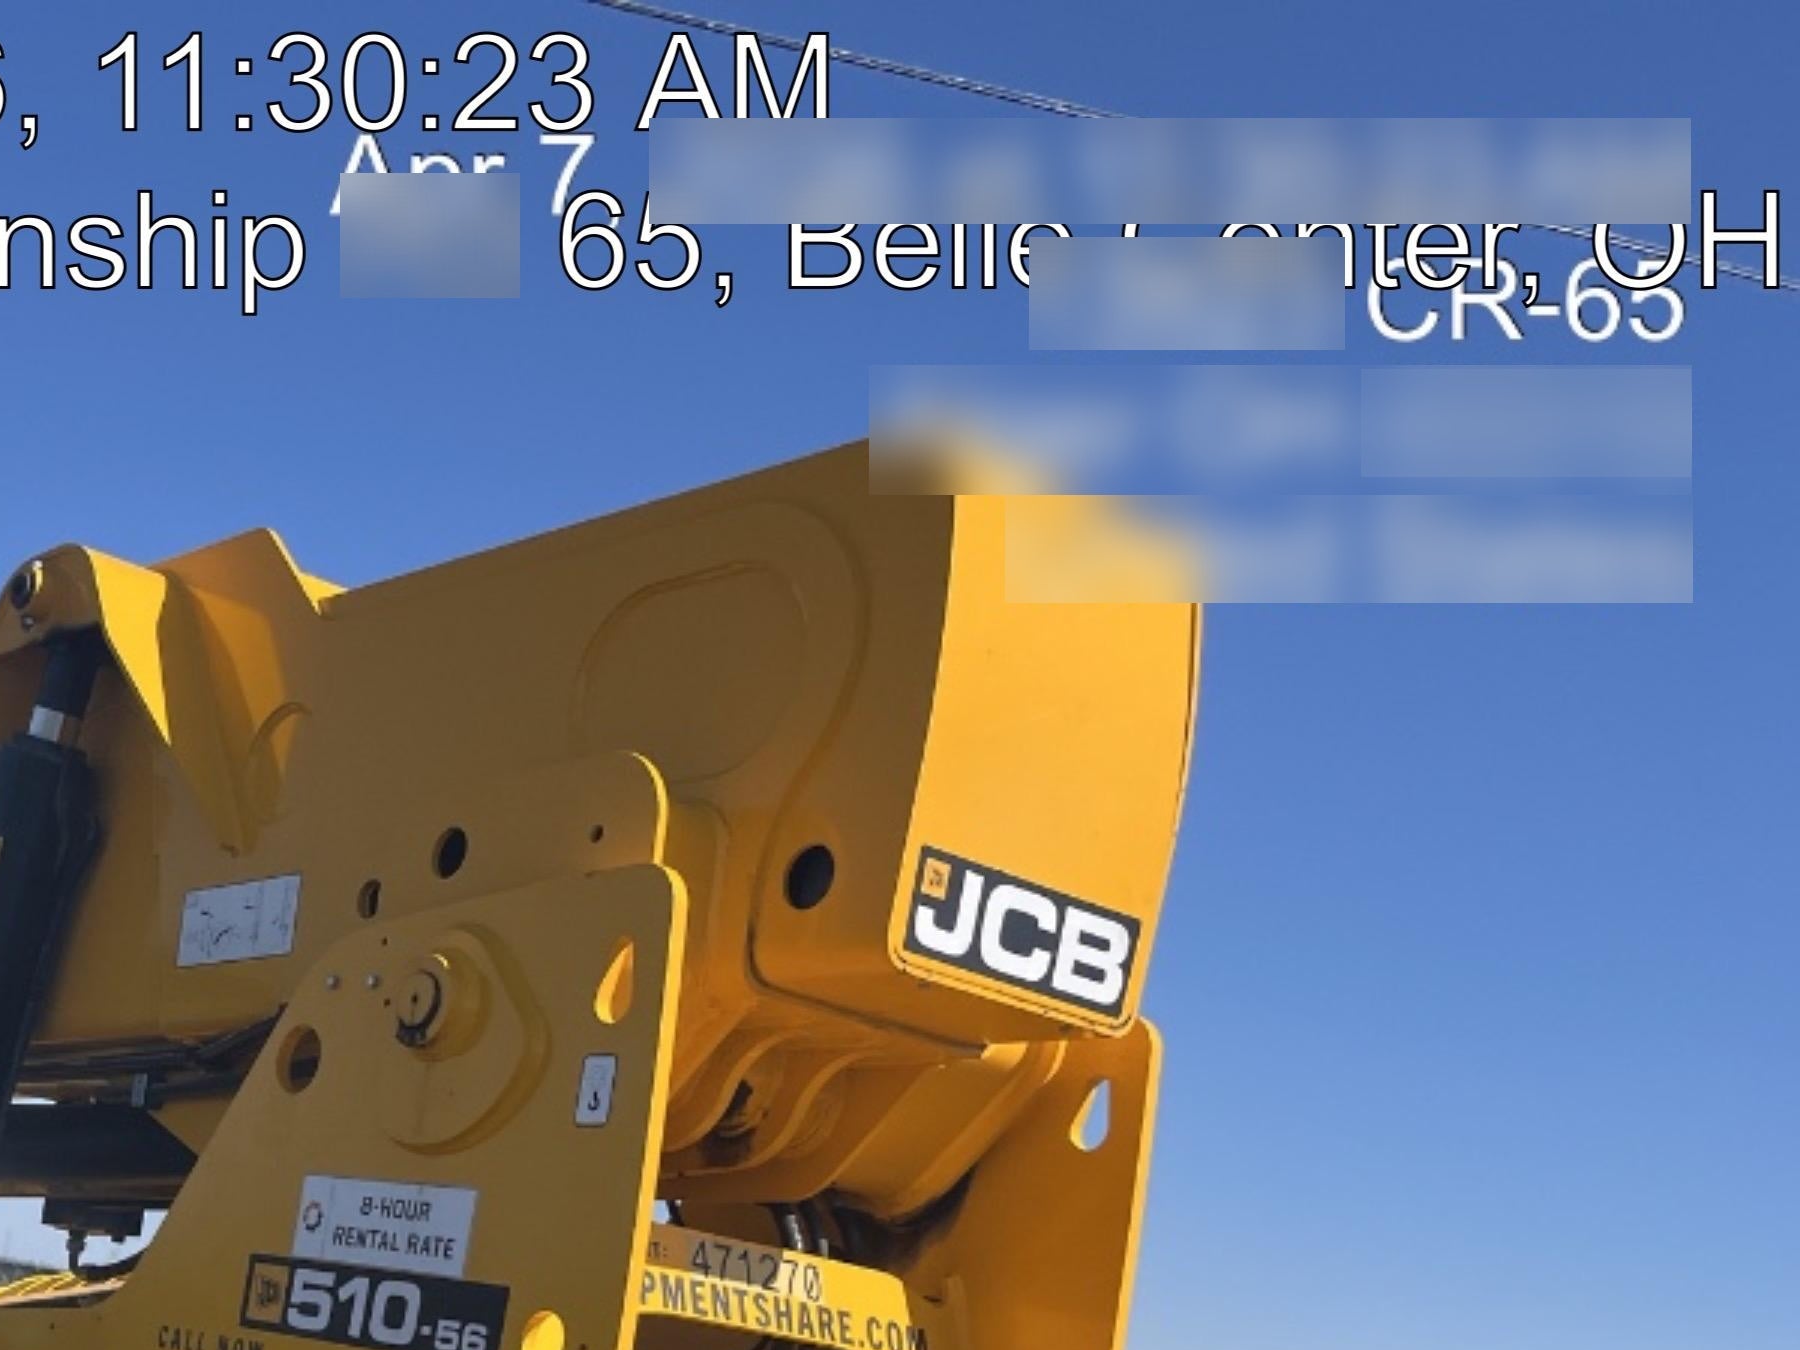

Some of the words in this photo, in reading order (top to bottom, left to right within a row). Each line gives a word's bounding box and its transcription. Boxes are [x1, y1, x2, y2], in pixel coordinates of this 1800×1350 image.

[914, 869, 1130, 1005] JCB
[358, 1196, 433, 1223] 8-HOUR
[331, 1226, 401, 1253] RENTAL
[405, 1232, 457, 1261] RATE
